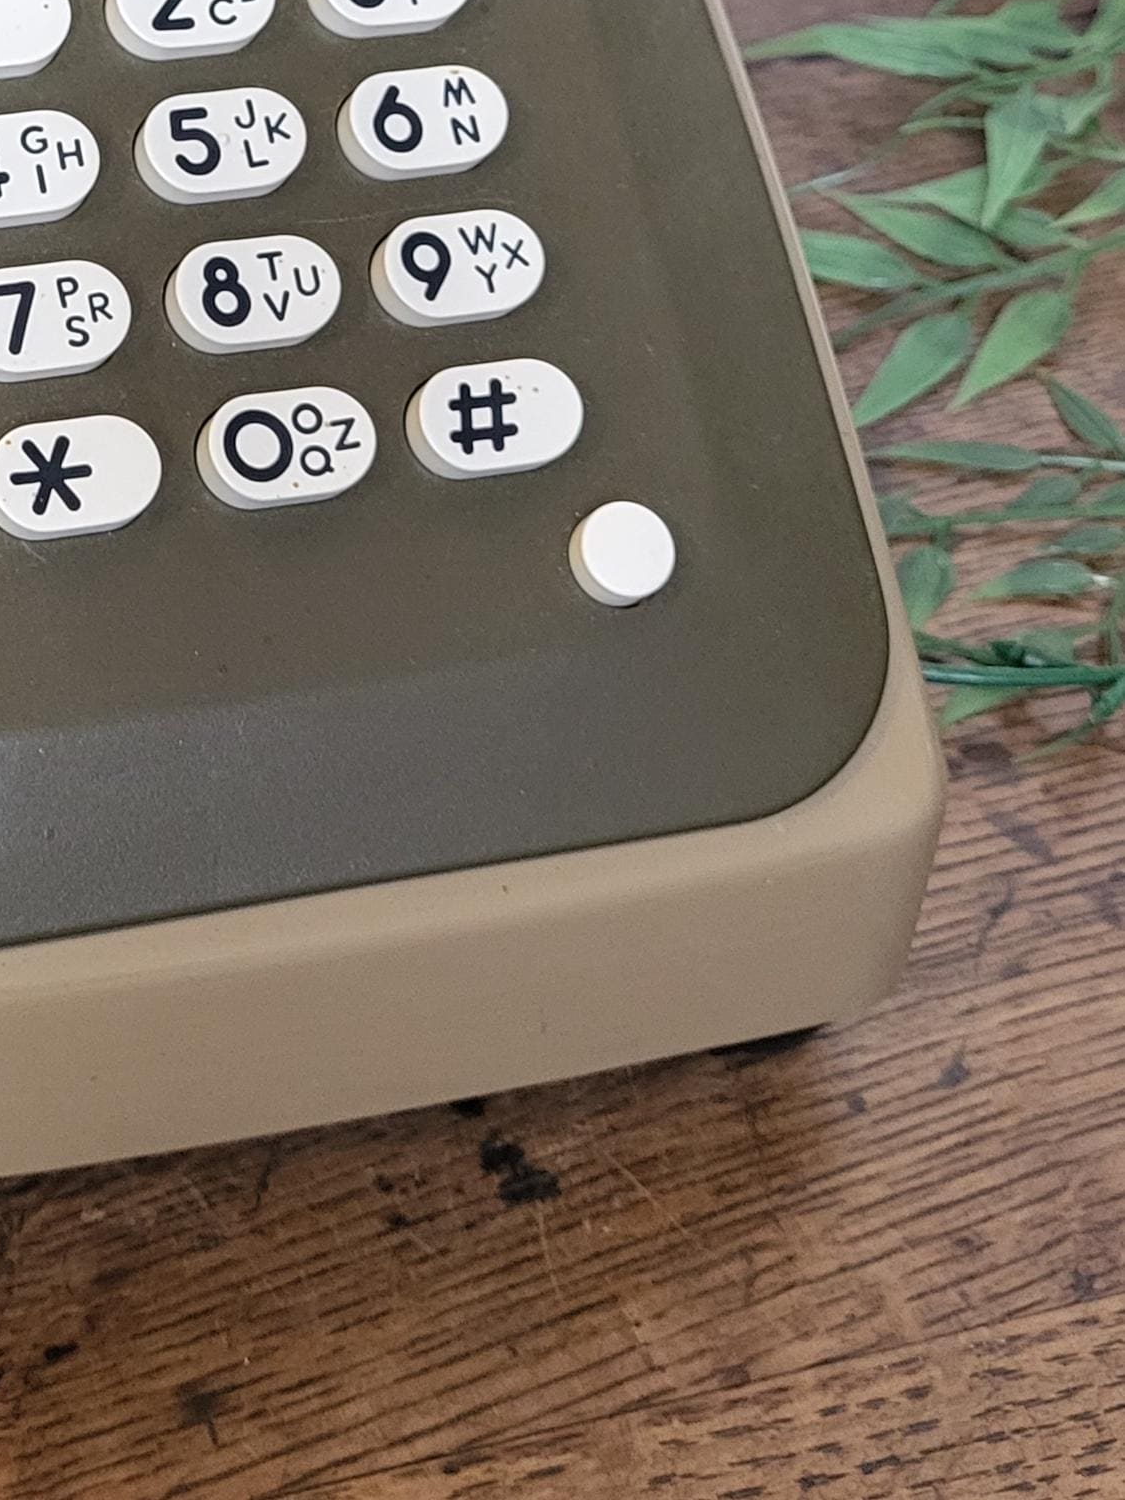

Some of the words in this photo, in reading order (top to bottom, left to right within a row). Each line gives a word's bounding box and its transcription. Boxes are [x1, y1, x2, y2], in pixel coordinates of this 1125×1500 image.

[169, 107, 222, 176] 5
[373, 85, 423, 153] 6
[201, 256, 252, 328] 8
[400, 231, 452, 302] 9
[448, 378, 519, 455] #
